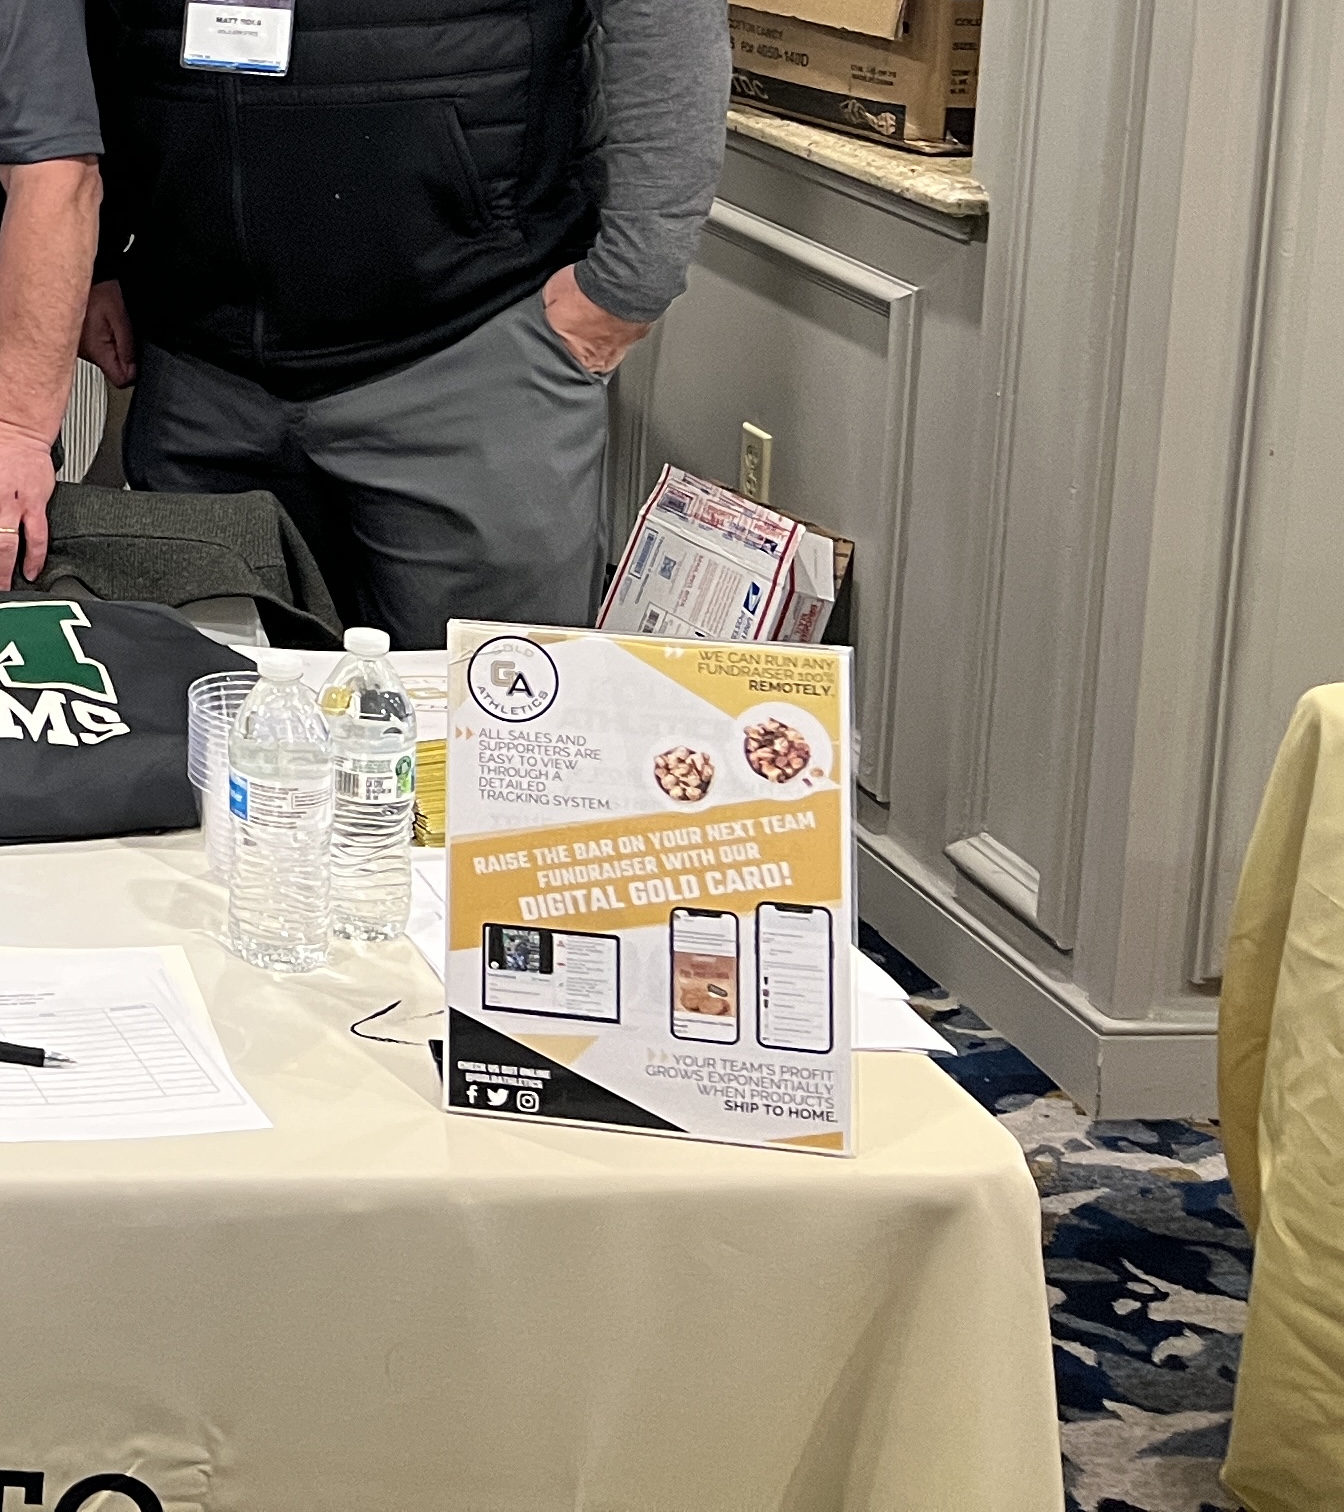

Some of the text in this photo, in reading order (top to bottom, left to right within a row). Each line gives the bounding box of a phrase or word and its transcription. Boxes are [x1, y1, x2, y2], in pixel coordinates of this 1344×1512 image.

[699, 650, 835, 670] WE CAN RUN ANY
[489, 659, 536, 700] GA
[697, 662, 794, 681] FUNDRAISER
[748, 679, 836, 697] REMOTELY.
[476, 685, 550, 717] ATHLETICS
[478, 727, 587, 747] ALL SALES AND
[478, 739, 602, 761] SUPPORTERS ARE
[478, 751, 579, 771] EASY TO VIEW
[478, 764, 563, 782] THROUGH A
[478, 776, 547, 793] DETAILED
[478, 788, 550, 806] TRACKING
[472, 810, 817, 876] RAISE THE BAR ON YOUR NEXT TEAM
[535, 841, 762, 889] FUNDRAISER WITH OUR
[517, 860, 794, 922] DIGITAL GOLD CARD!
[673, 1054, 835, 1081] YOUR TEAM'S PROFIT
[645, 1064, 835, 1096] GROWS EXPONENTIALLY
[697, 1082, 836, 1109] WHEN PRODUCTS
[724, 1099, 760, 1114] SHIP
[762, 1104, 785, 1117] TO
